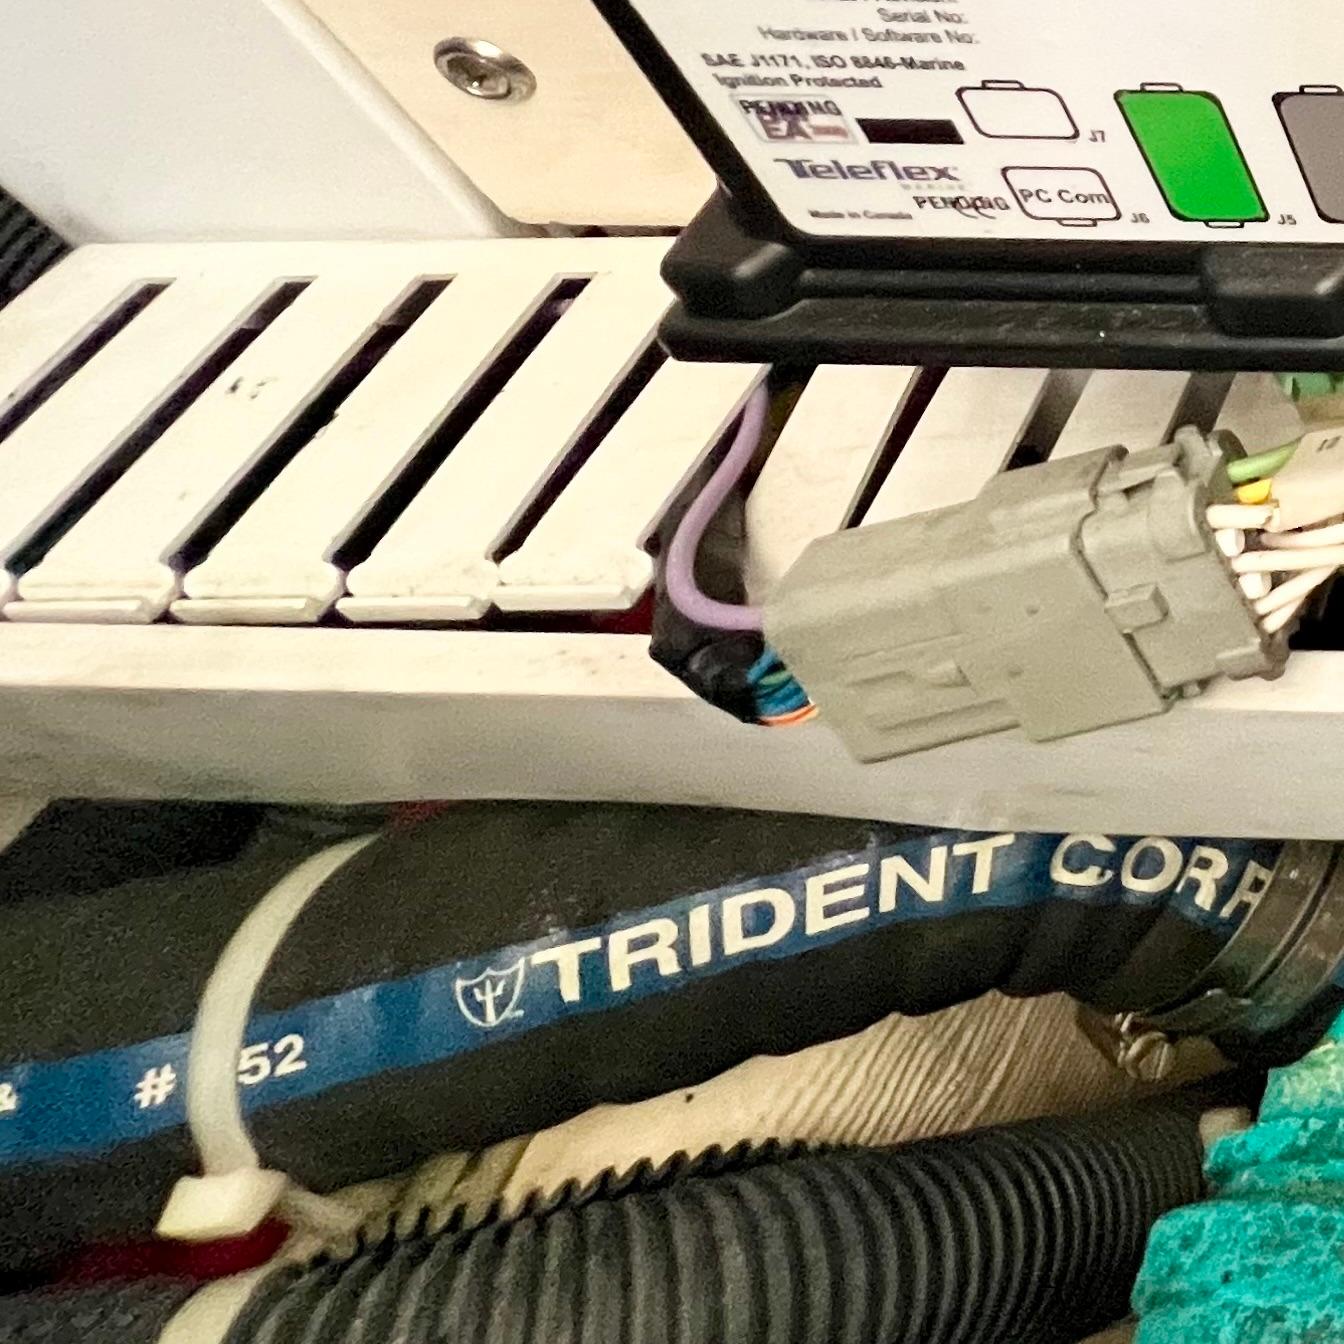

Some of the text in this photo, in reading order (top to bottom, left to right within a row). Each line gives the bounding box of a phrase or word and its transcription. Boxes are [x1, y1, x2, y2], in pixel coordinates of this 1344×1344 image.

[877, 7, 932, 23] Serial
[758, 26, 848, 42] Hardware
[862, 27, 942, 44] Software
[701, 53, 745, 68] SAE
[751, 53, 812, 70] J1171,
[811, 54, 849, 69] ISO
[712, 73, 883, 89] Ignition Protected
[1088, 129, 1106, 143] J7
[773, 158, 960, 180] Teleflex
[1019, 187, 1111, 205] PC Com
[1277, 213, 1297, 227] J5
[527, 832, 1016, 1004] TRIDENT
